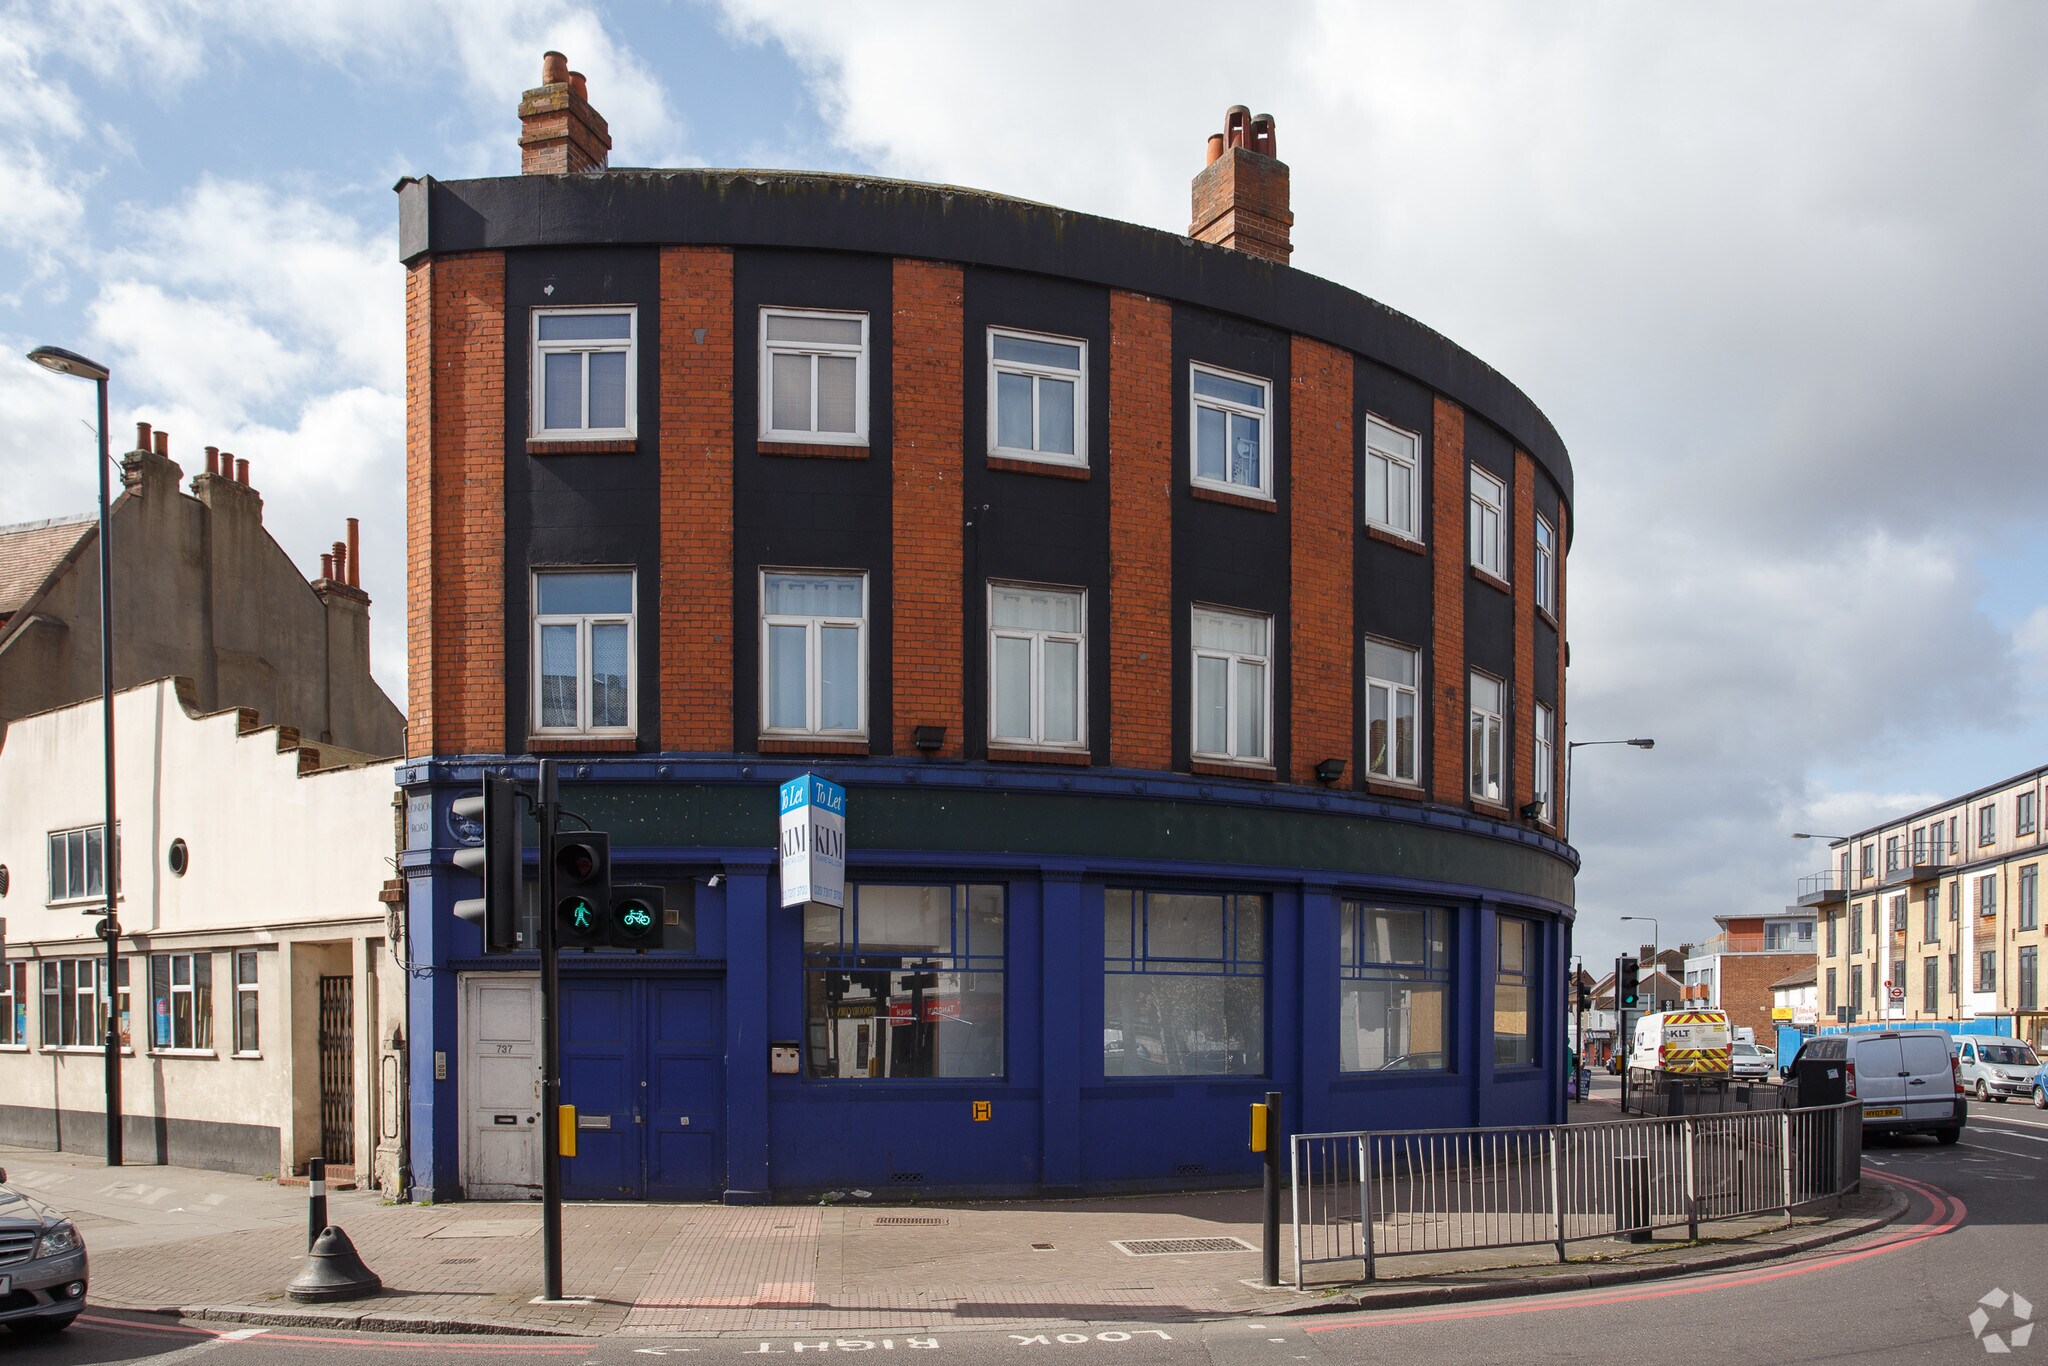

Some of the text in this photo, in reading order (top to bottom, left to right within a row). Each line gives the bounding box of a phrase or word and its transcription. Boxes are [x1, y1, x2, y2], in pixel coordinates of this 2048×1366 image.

[409, 802, 431, 813] LONDON
[782, 785, 804, 811] To Let
[816, 782, 842, 811] To Let
[412, 823, 428, 832] ROAD
[782, 824, 805, 859] KLM
[815, 824, 843, 860] KLM
[497, 1045, 513, 1053] 737
[976, 1103, 989, 1119] H
[744, 1330, 1173, 1353] LOOK RIGHT
